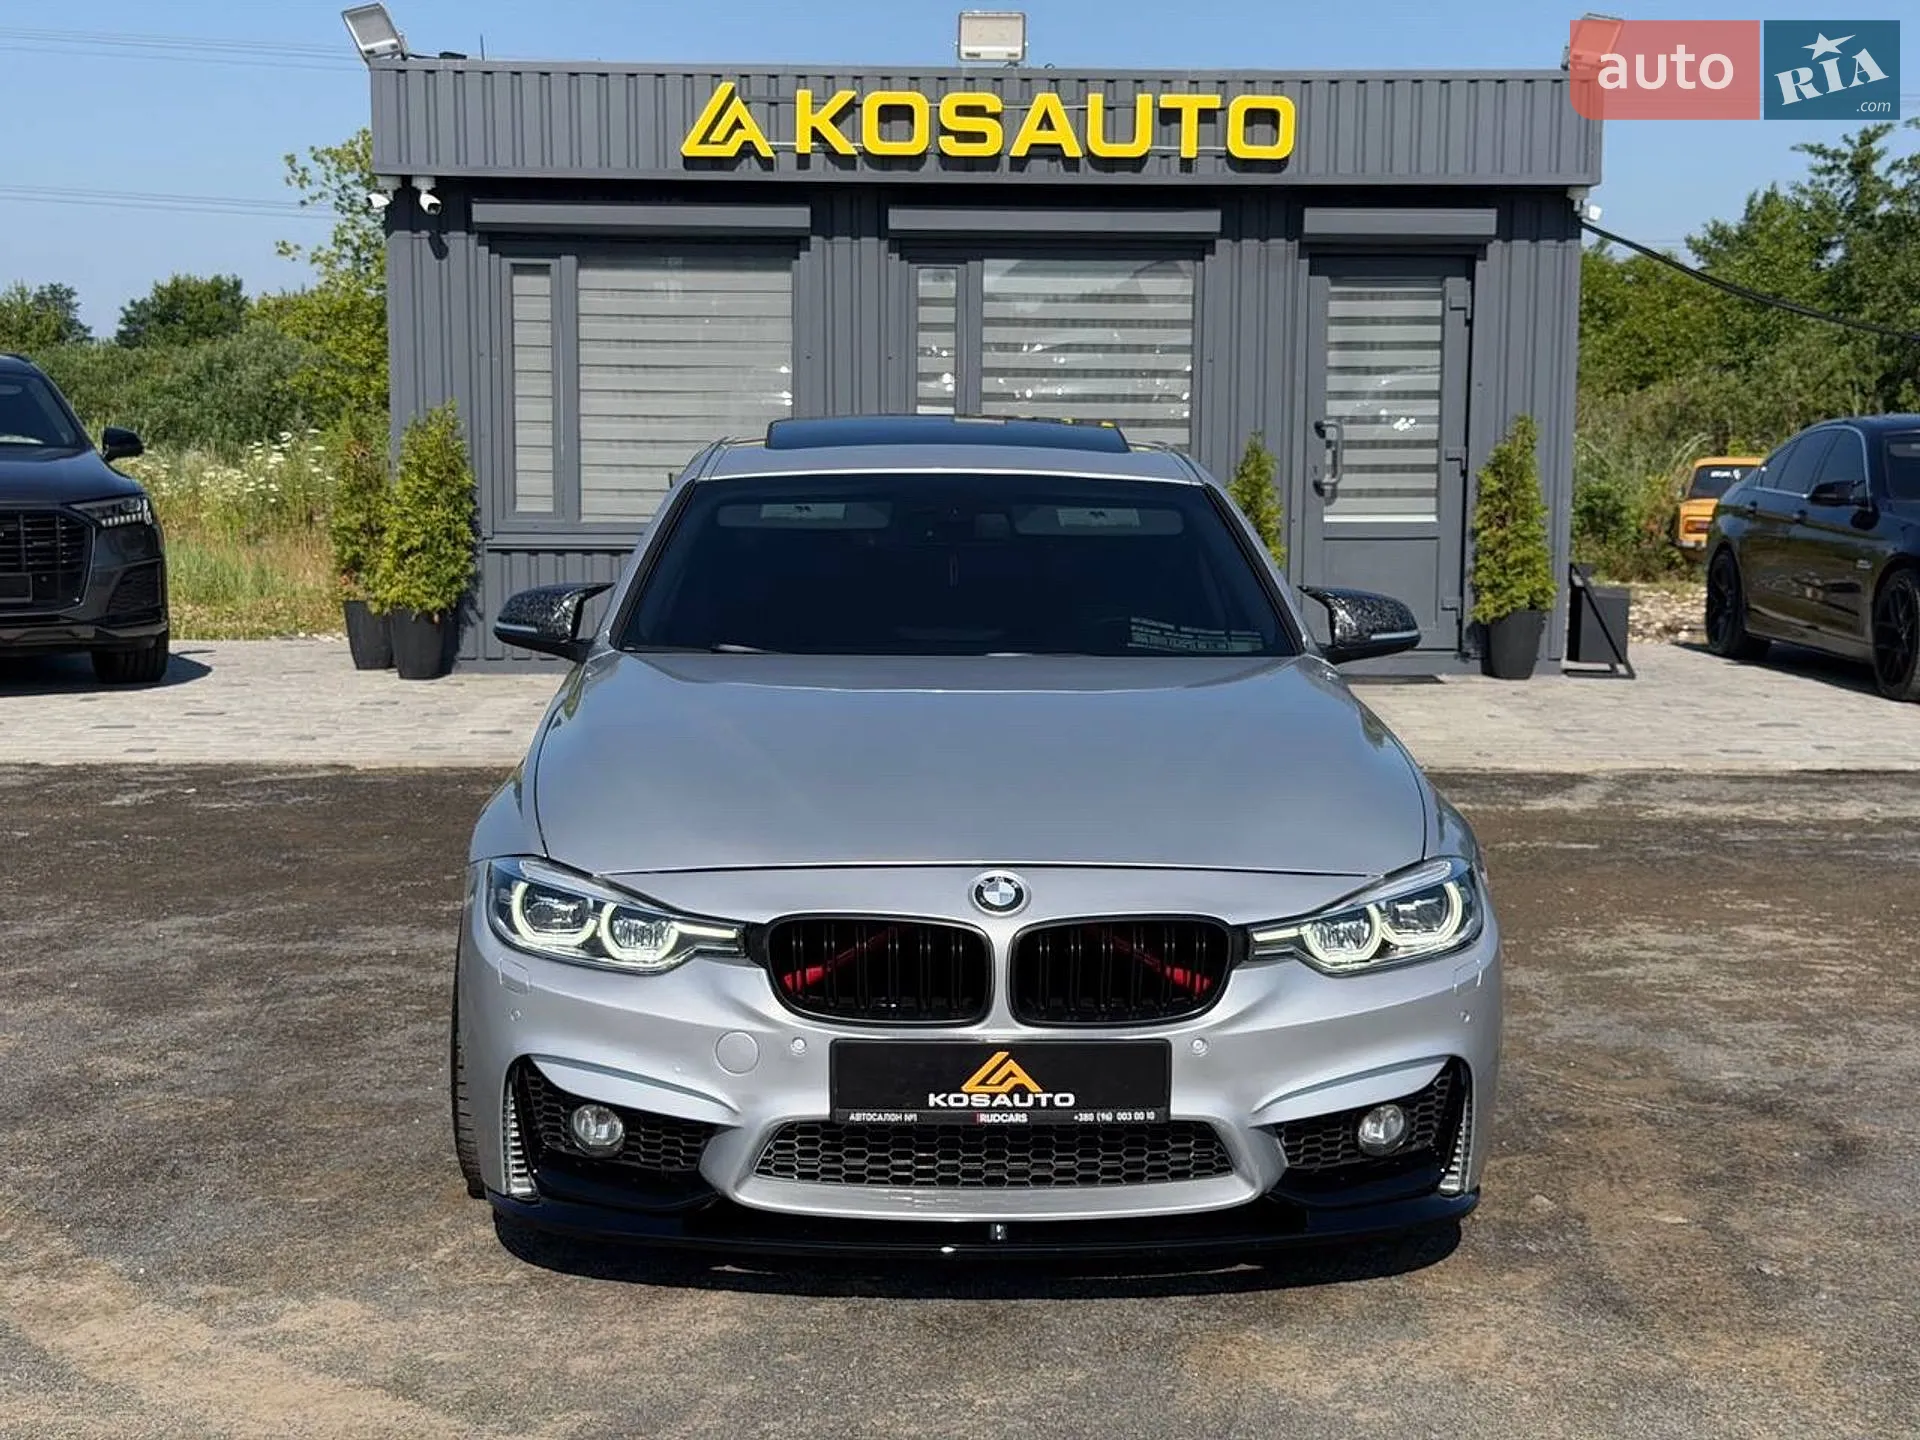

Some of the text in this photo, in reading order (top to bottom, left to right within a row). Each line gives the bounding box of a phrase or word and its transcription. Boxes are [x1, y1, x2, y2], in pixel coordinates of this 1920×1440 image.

[796, 89, 1296, 160] KOSAUTO
[928, 1093, 1075, 1107] KOSAUTO
[849, 1112, 902, 1122] АВТОСАЛОН
